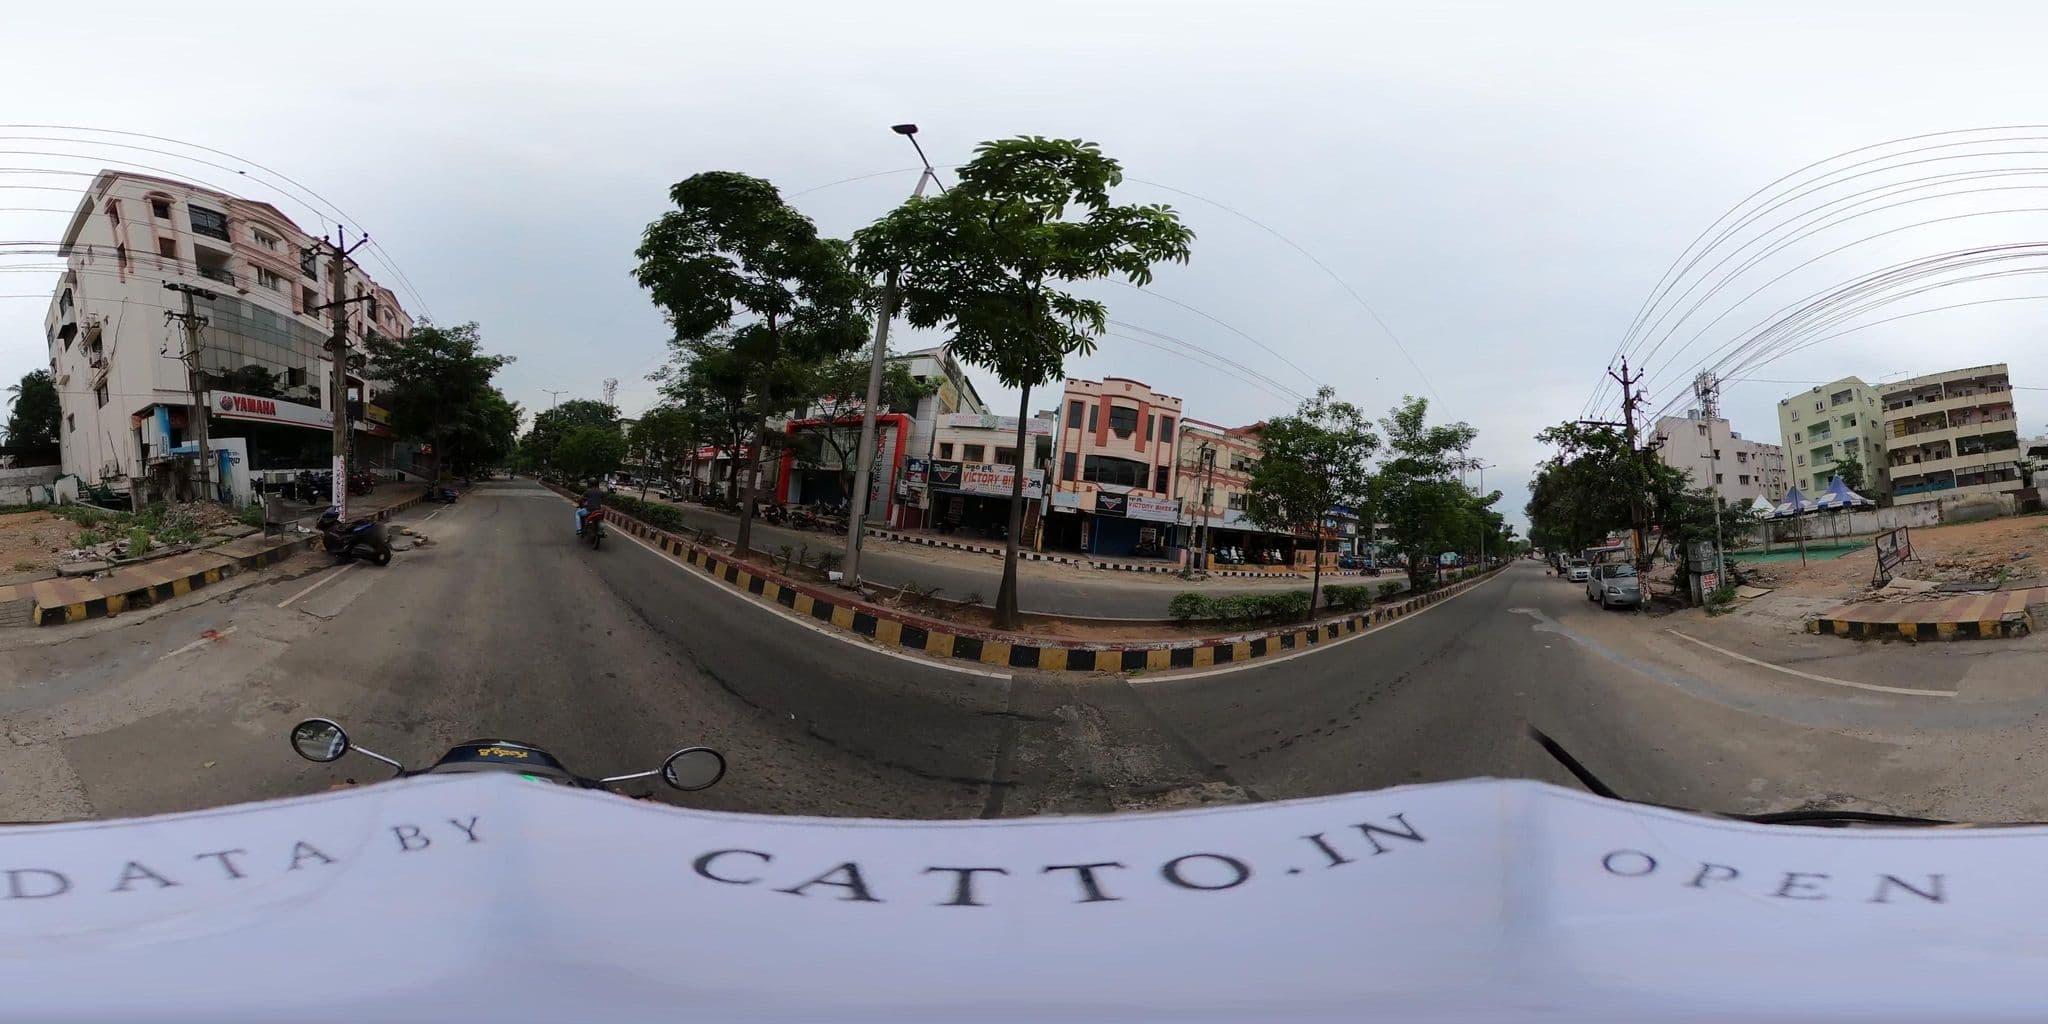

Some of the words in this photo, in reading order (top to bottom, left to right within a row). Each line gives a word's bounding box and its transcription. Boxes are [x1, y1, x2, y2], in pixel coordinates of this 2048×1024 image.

[233, 396, 276, 415] YAMAHA
[963, 472, 999, 484] VICTORY
[2, 839, 340, 900] DATA
[391, 816, 485, 853] BY
[692, 812, 1426, 906] CATTO.IN
[1602, 850, 1948, 904] OPEN
